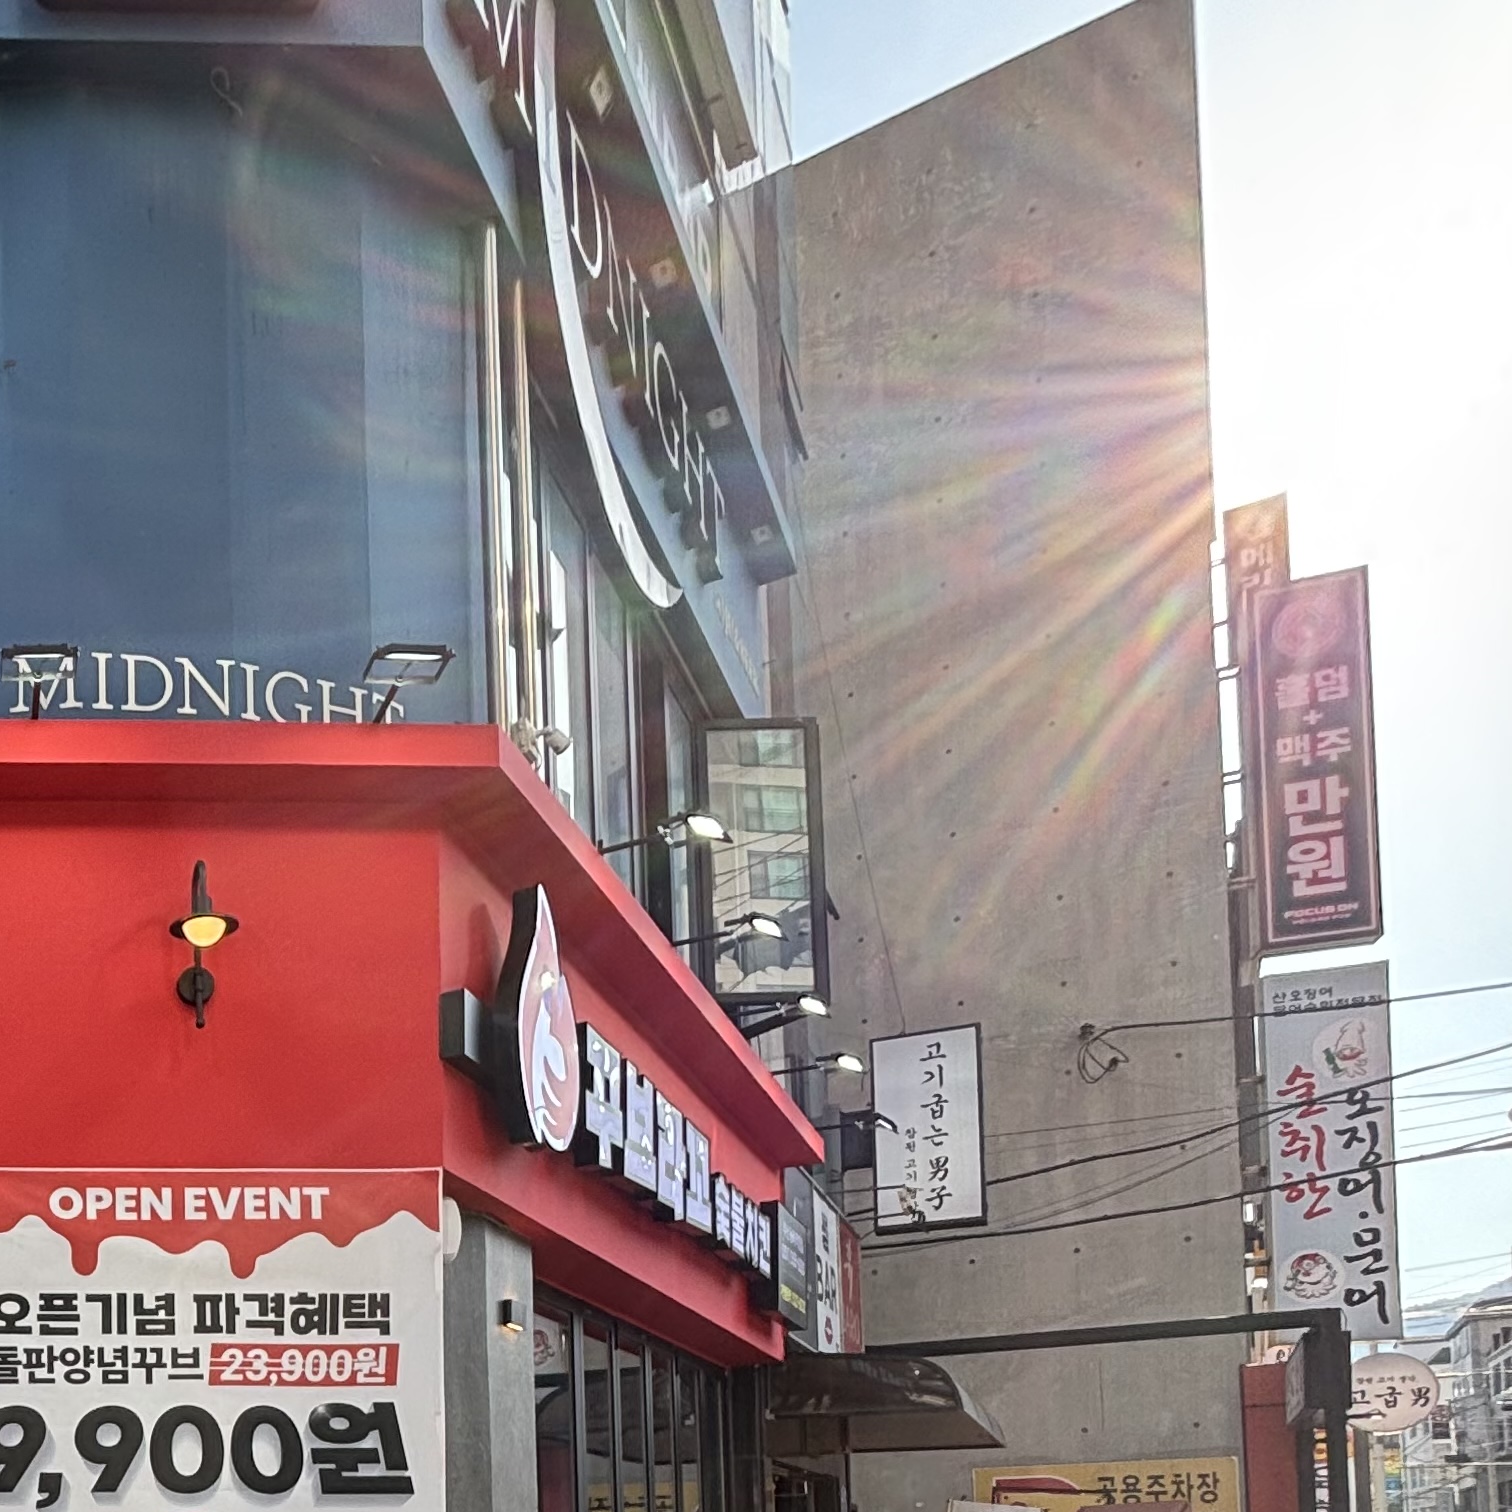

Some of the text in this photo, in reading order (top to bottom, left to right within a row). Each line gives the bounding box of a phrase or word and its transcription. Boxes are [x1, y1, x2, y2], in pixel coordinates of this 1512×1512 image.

[1275, 664, 1350, 710] 홀덤
[1275, 725, 1352, 767] 맥주
[1283, 775, 1351, 897] 만원
[1276, 1064, 1333, 1220] 술취한
[49, 1186, 330, 1221] OPEN EVENT
[193, 1291, 392, 1336] 파격혜택
[219, 1346, 388, 1388] 23,900원
[1096, 1472, 1220, 1505] 공용주차장
